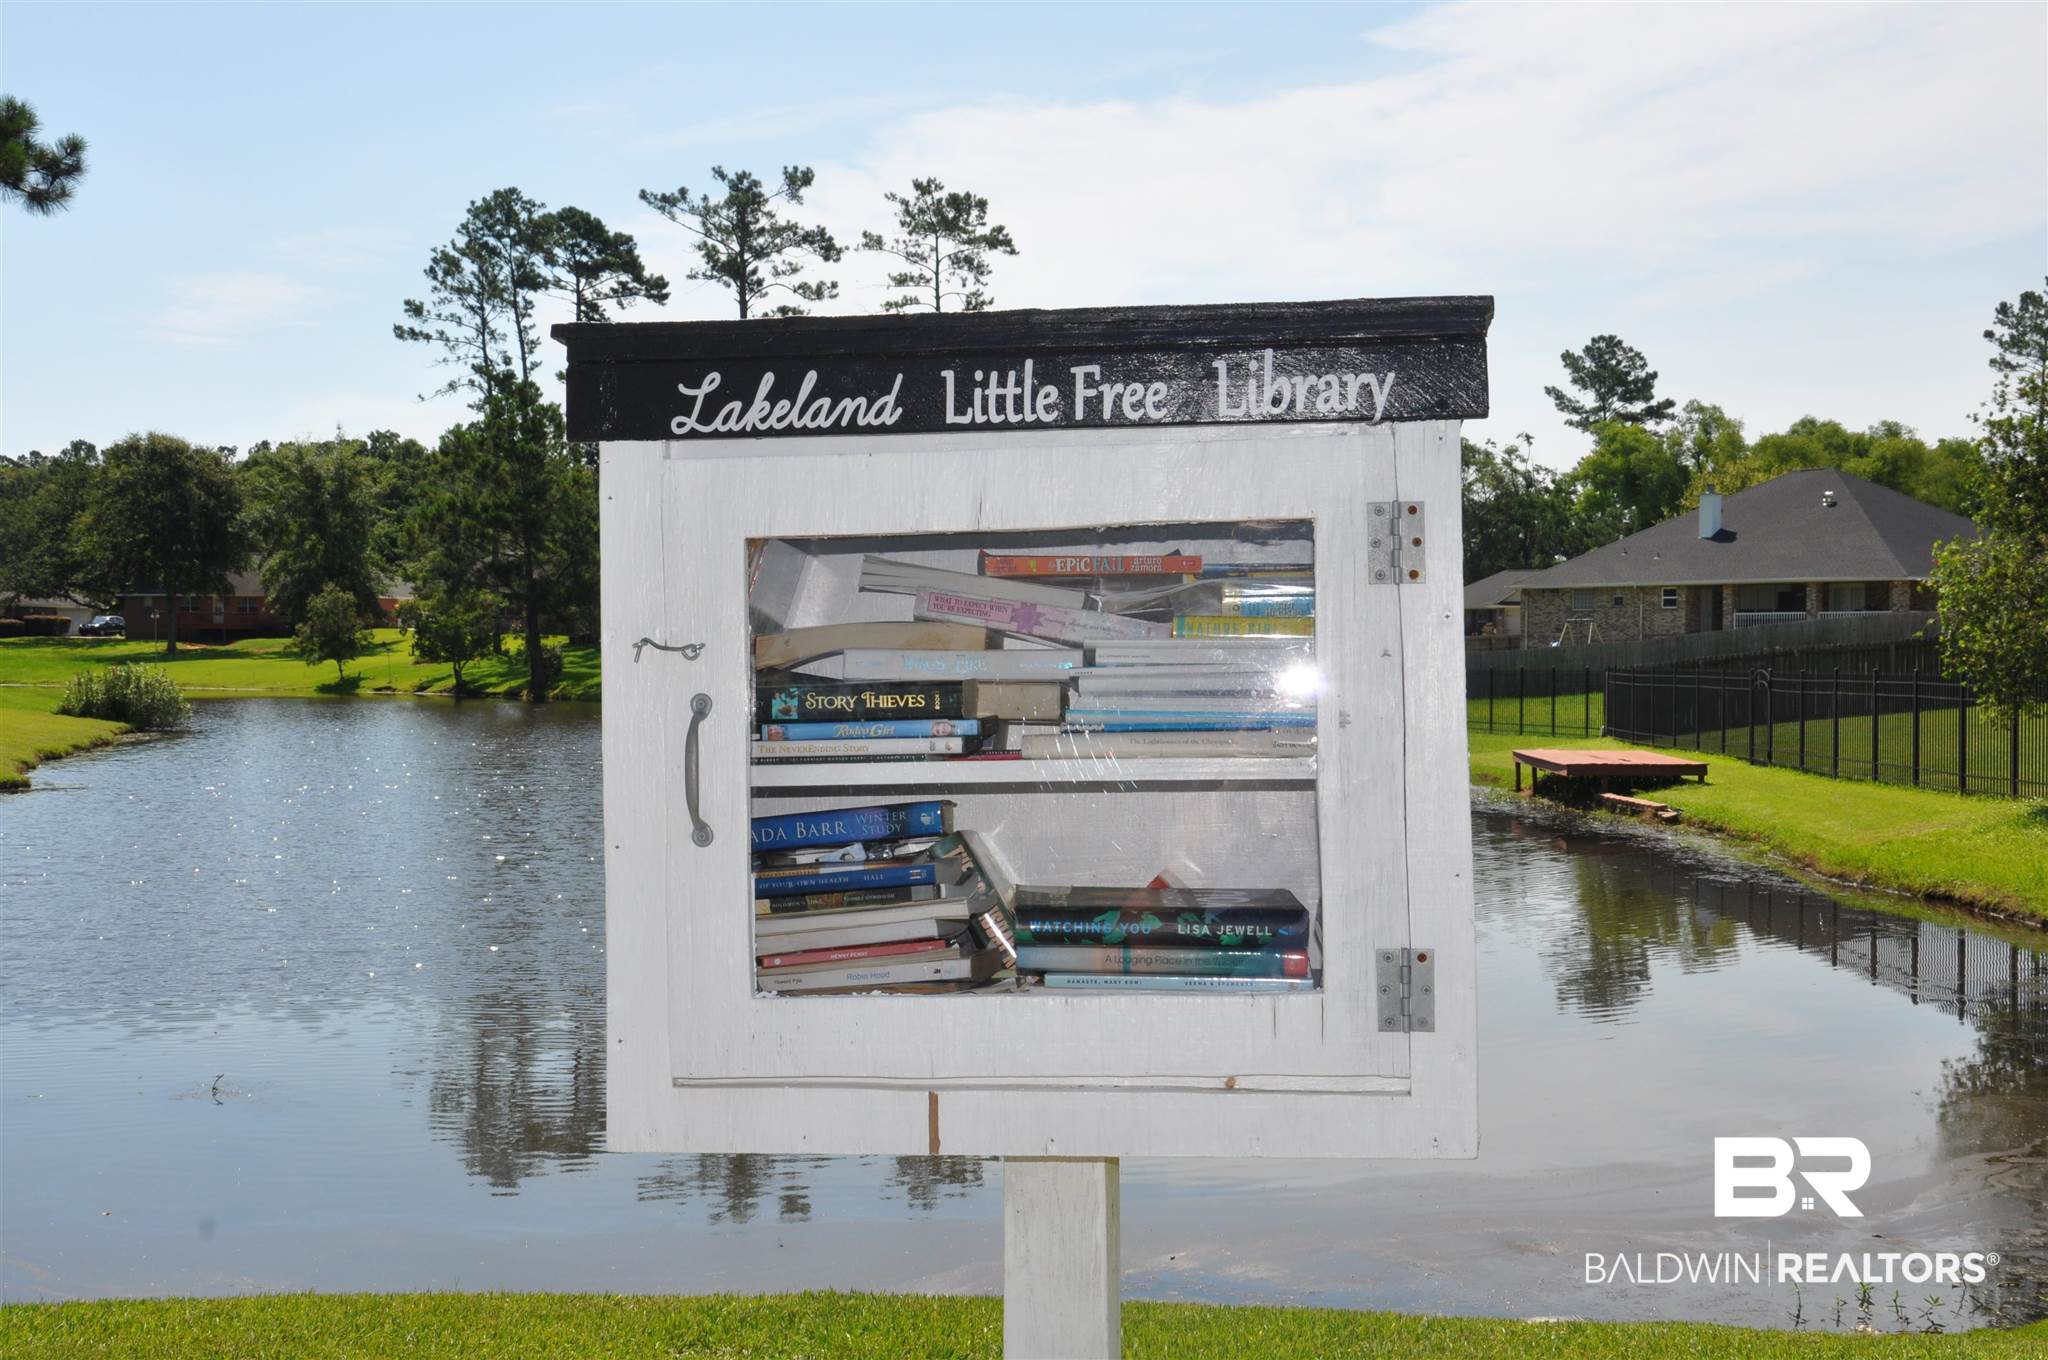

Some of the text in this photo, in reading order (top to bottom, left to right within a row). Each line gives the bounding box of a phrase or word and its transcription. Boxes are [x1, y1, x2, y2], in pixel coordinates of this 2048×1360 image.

[671, 348, 1396, 435] Lakeland Little Free Library
[1093, 557, 1125, 572] FAIL
[805, 692, 858, 712] STORY
[860, 690, 926, 709] THIEVES
[855, 810, 907, 825] WINTER
[796, 820, 849, 839] BARR
[861, 822, 902, 836] STUDY
[1029, 920, 1273, 937] WATCHING YOU LISA JEWELL
[846, 972, 869, 982] Robin
[870, 970, 891, 980] Hood
